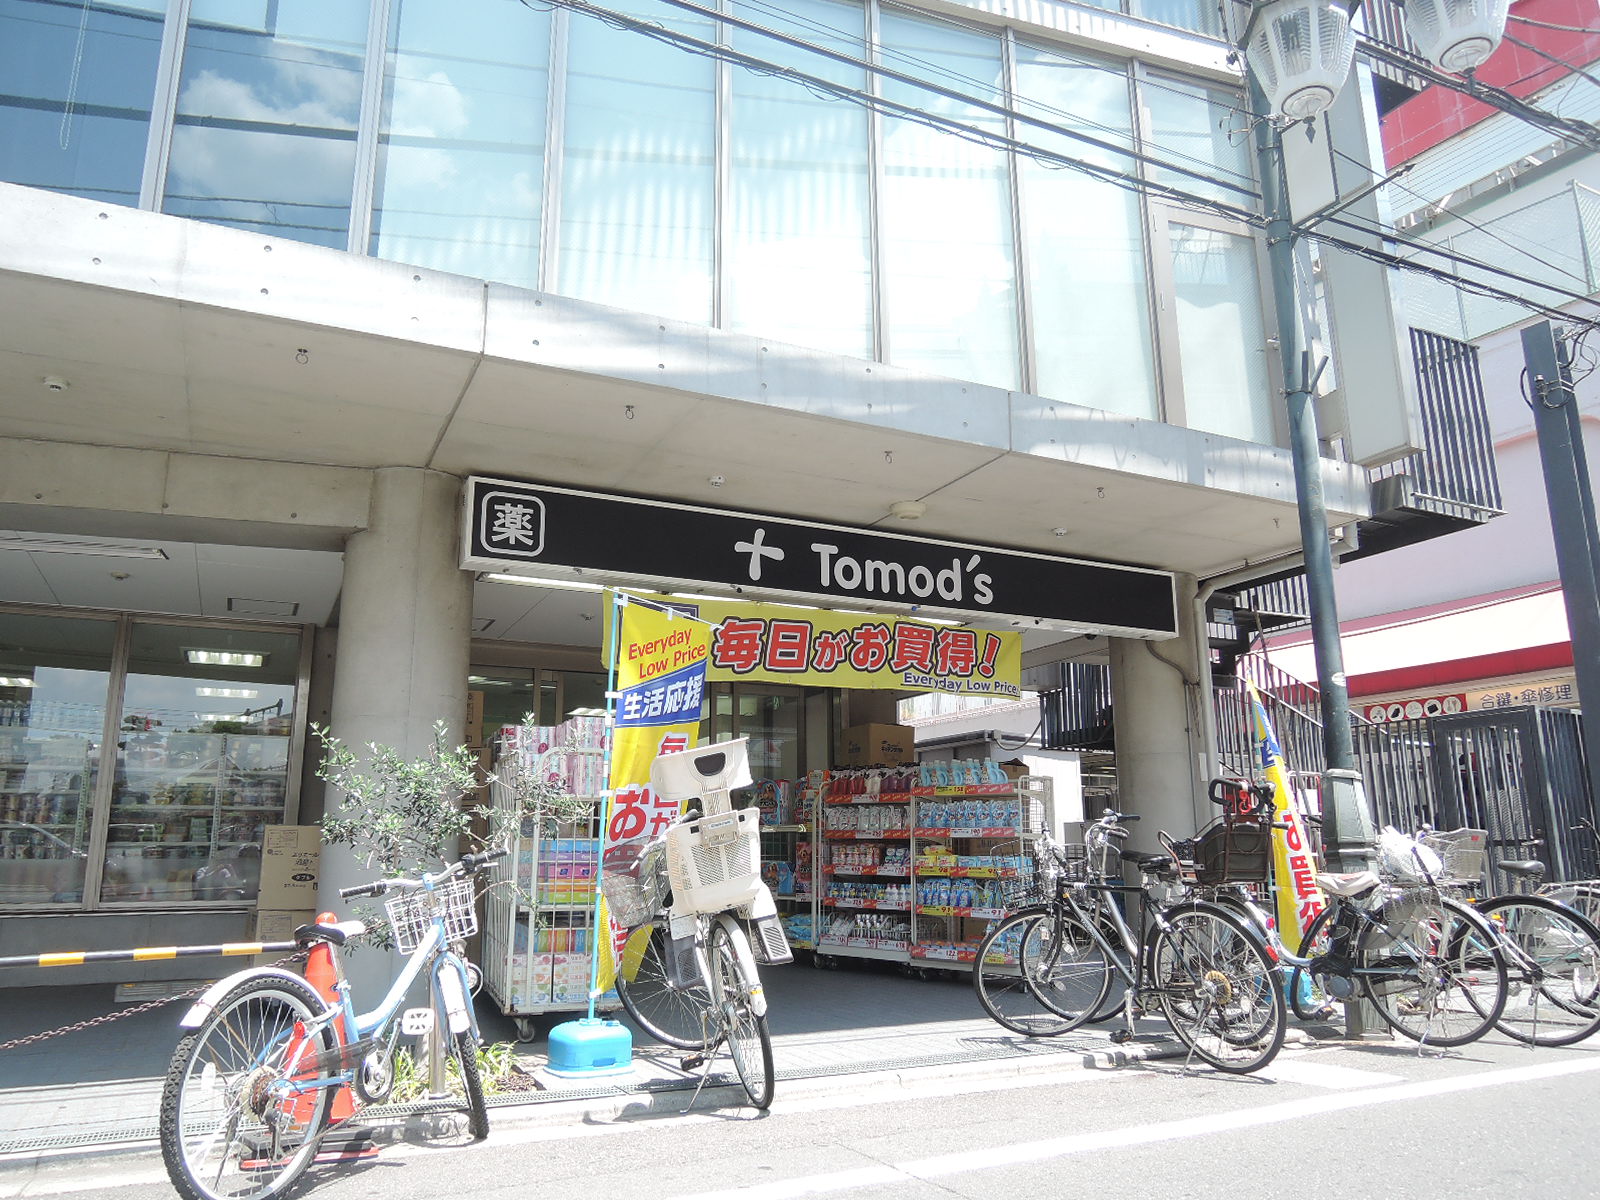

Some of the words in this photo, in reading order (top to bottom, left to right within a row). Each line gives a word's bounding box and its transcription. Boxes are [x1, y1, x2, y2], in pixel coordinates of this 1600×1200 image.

[491, 502, 534, 546] 薬
[810, 543, 994, 605] Tomod's
[628, 628, 692, 661] Everyday
[639, 658, 669, 679] Low
[673, 643, 706, 667] Price
[713, 618, 1000, 677] 毎日がお買得!
[622, 672, 704, 720] 生活応援
[904, 672, 962, 692] Everyday
[966, 679, 991, 692] Low
